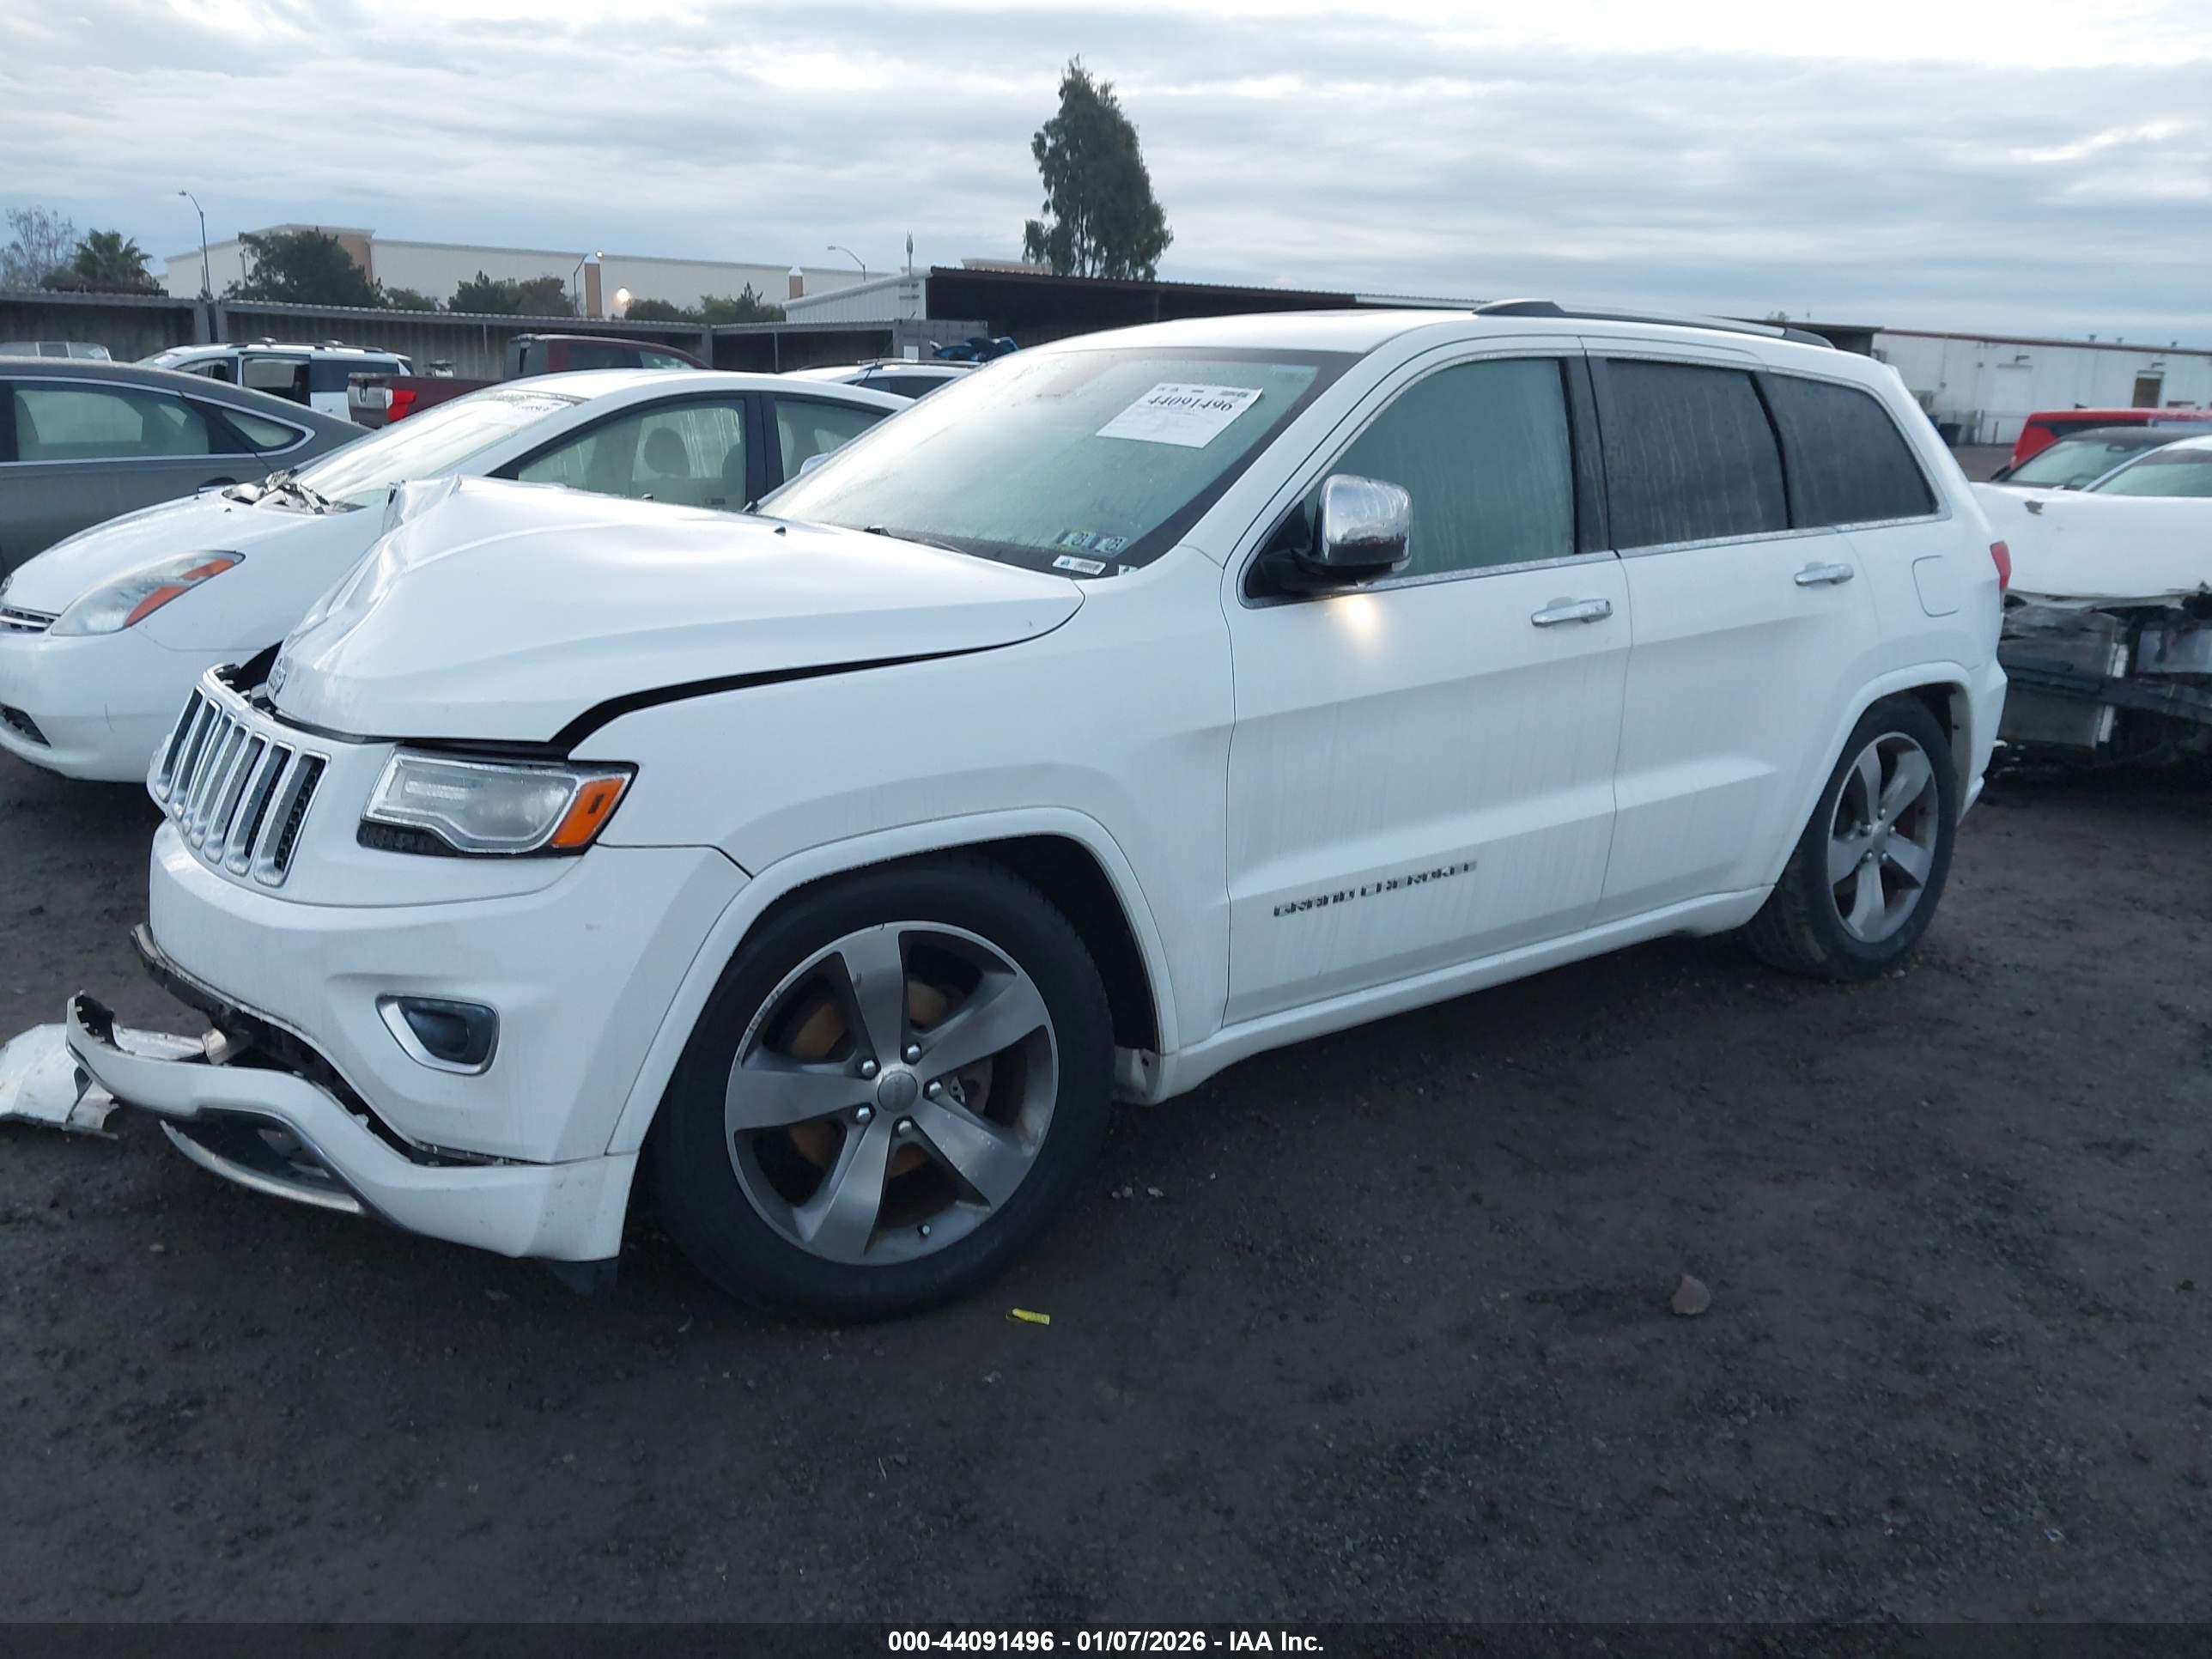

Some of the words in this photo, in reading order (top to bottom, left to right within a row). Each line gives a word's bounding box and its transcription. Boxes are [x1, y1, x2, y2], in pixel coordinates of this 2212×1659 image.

[1148, 395, 1234, 411] 44091496
[1273, 888, 1356, 917] GRAND
[1359, 860, 1478, 896] CHEROKEE
